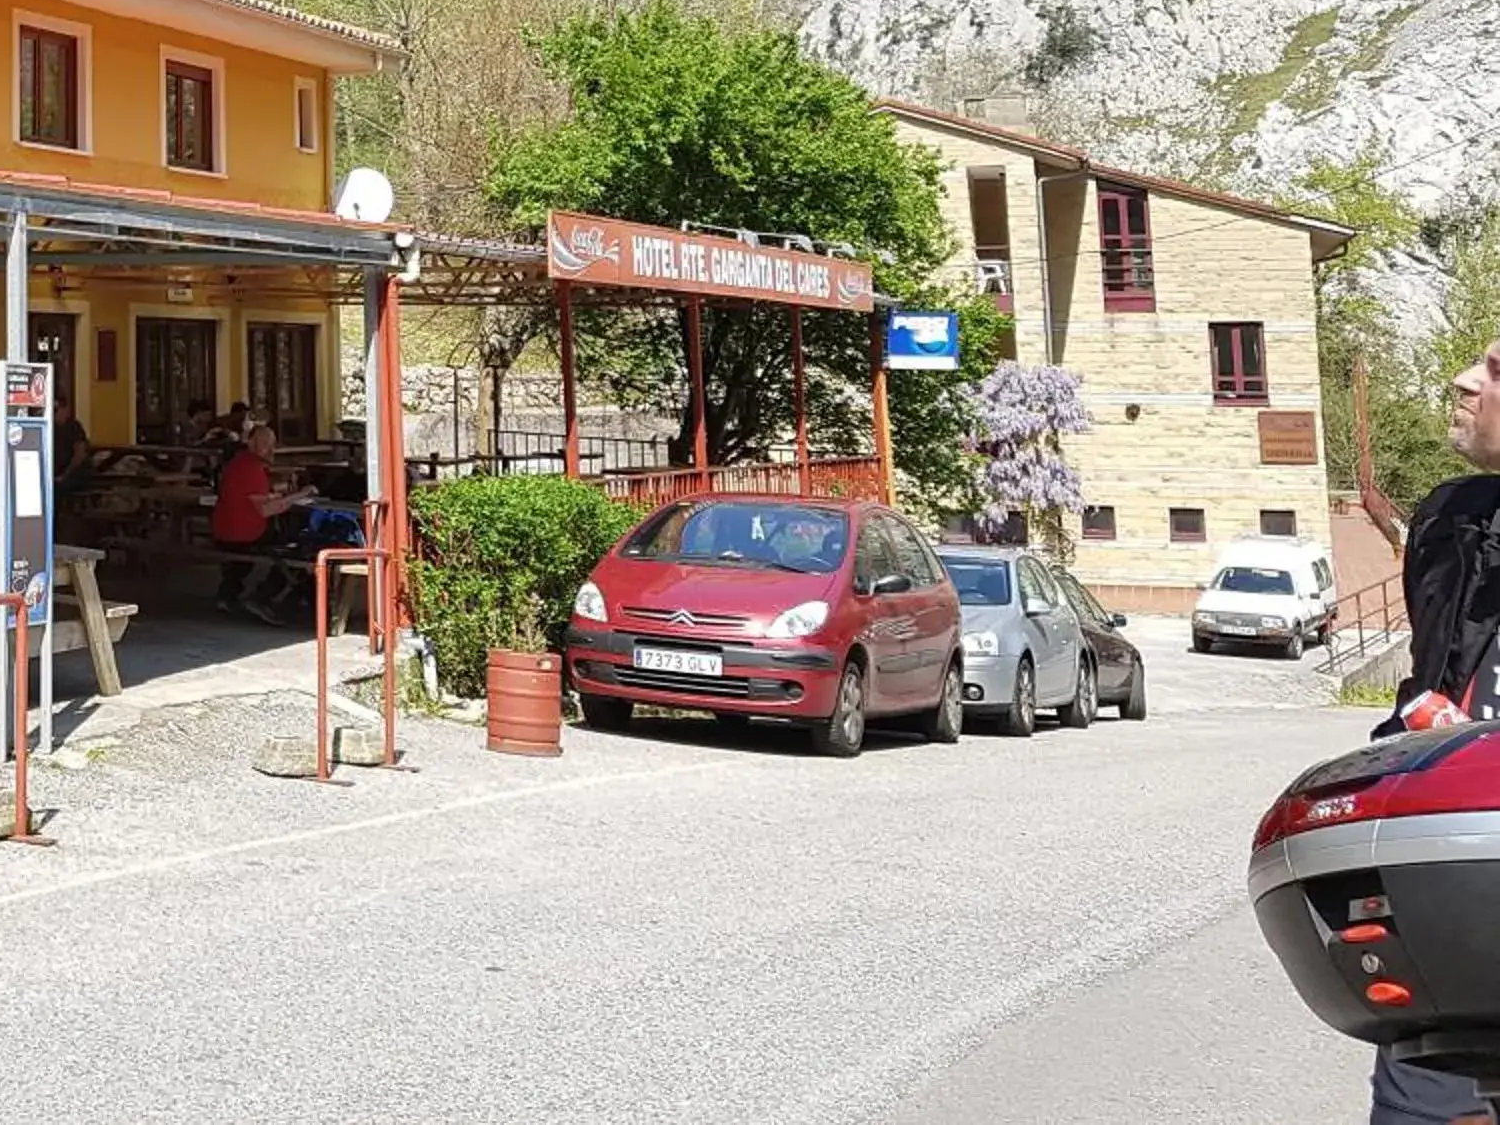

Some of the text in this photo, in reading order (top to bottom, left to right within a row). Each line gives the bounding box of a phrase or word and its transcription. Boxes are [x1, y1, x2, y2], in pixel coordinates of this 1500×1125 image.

[632, 235, 679, 279] HOTEL
[711, 246, 774, 289] GARGANTA
[775, 258, 797, 293] DEL
[797, 262, 831, 299] CARES
[645, 652, 683, 670] 7373
